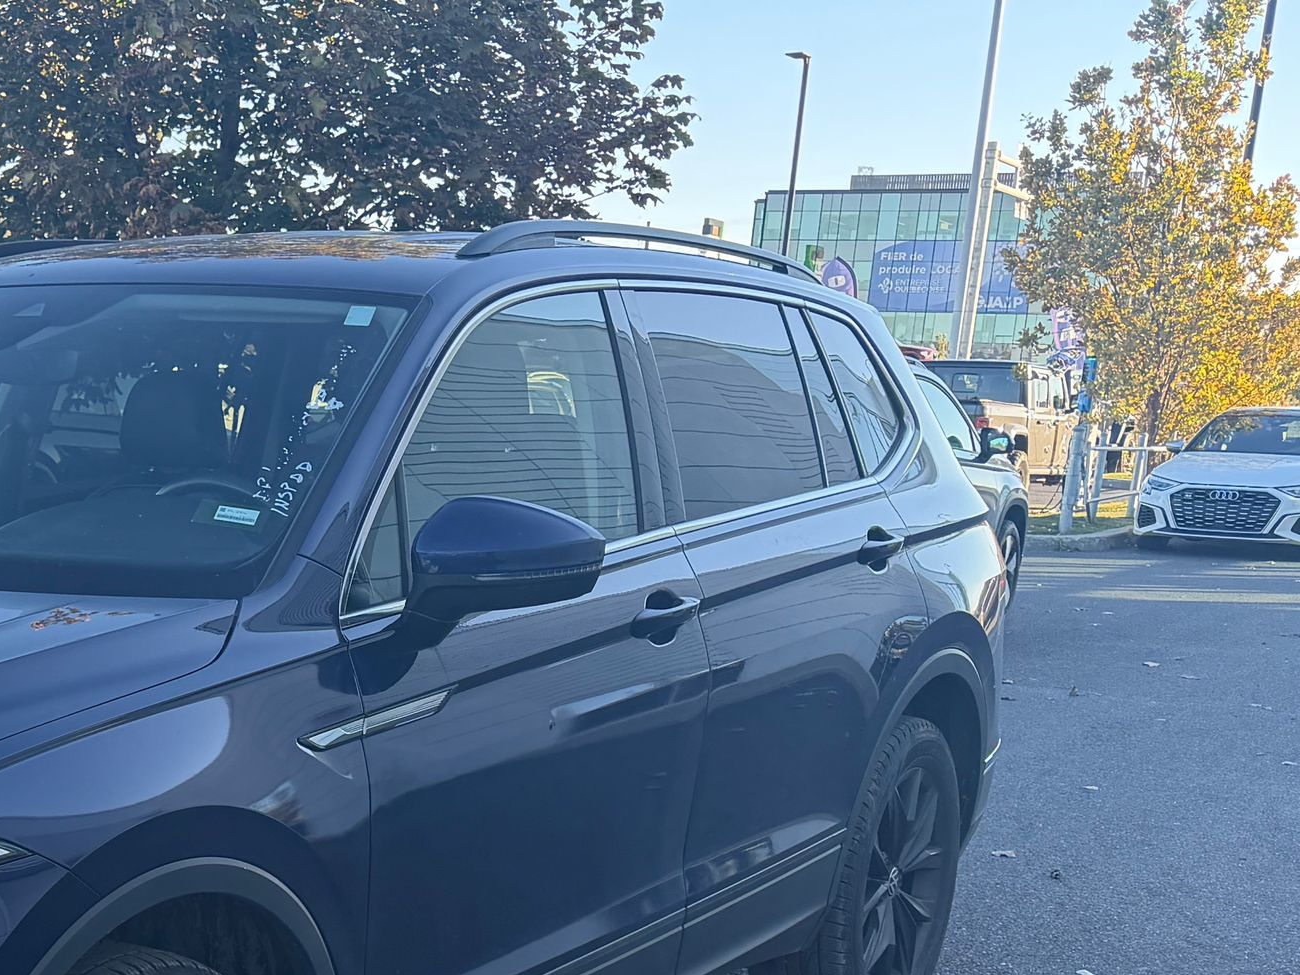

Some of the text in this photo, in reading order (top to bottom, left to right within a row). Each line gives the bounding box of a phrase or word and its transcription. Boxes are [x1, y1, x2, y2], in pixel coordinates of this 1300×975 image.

[881, 251, 924, 261] FIER de
[879, 264, 961, 275] produire LOCA
[271, 481, 298, 517] INSP
